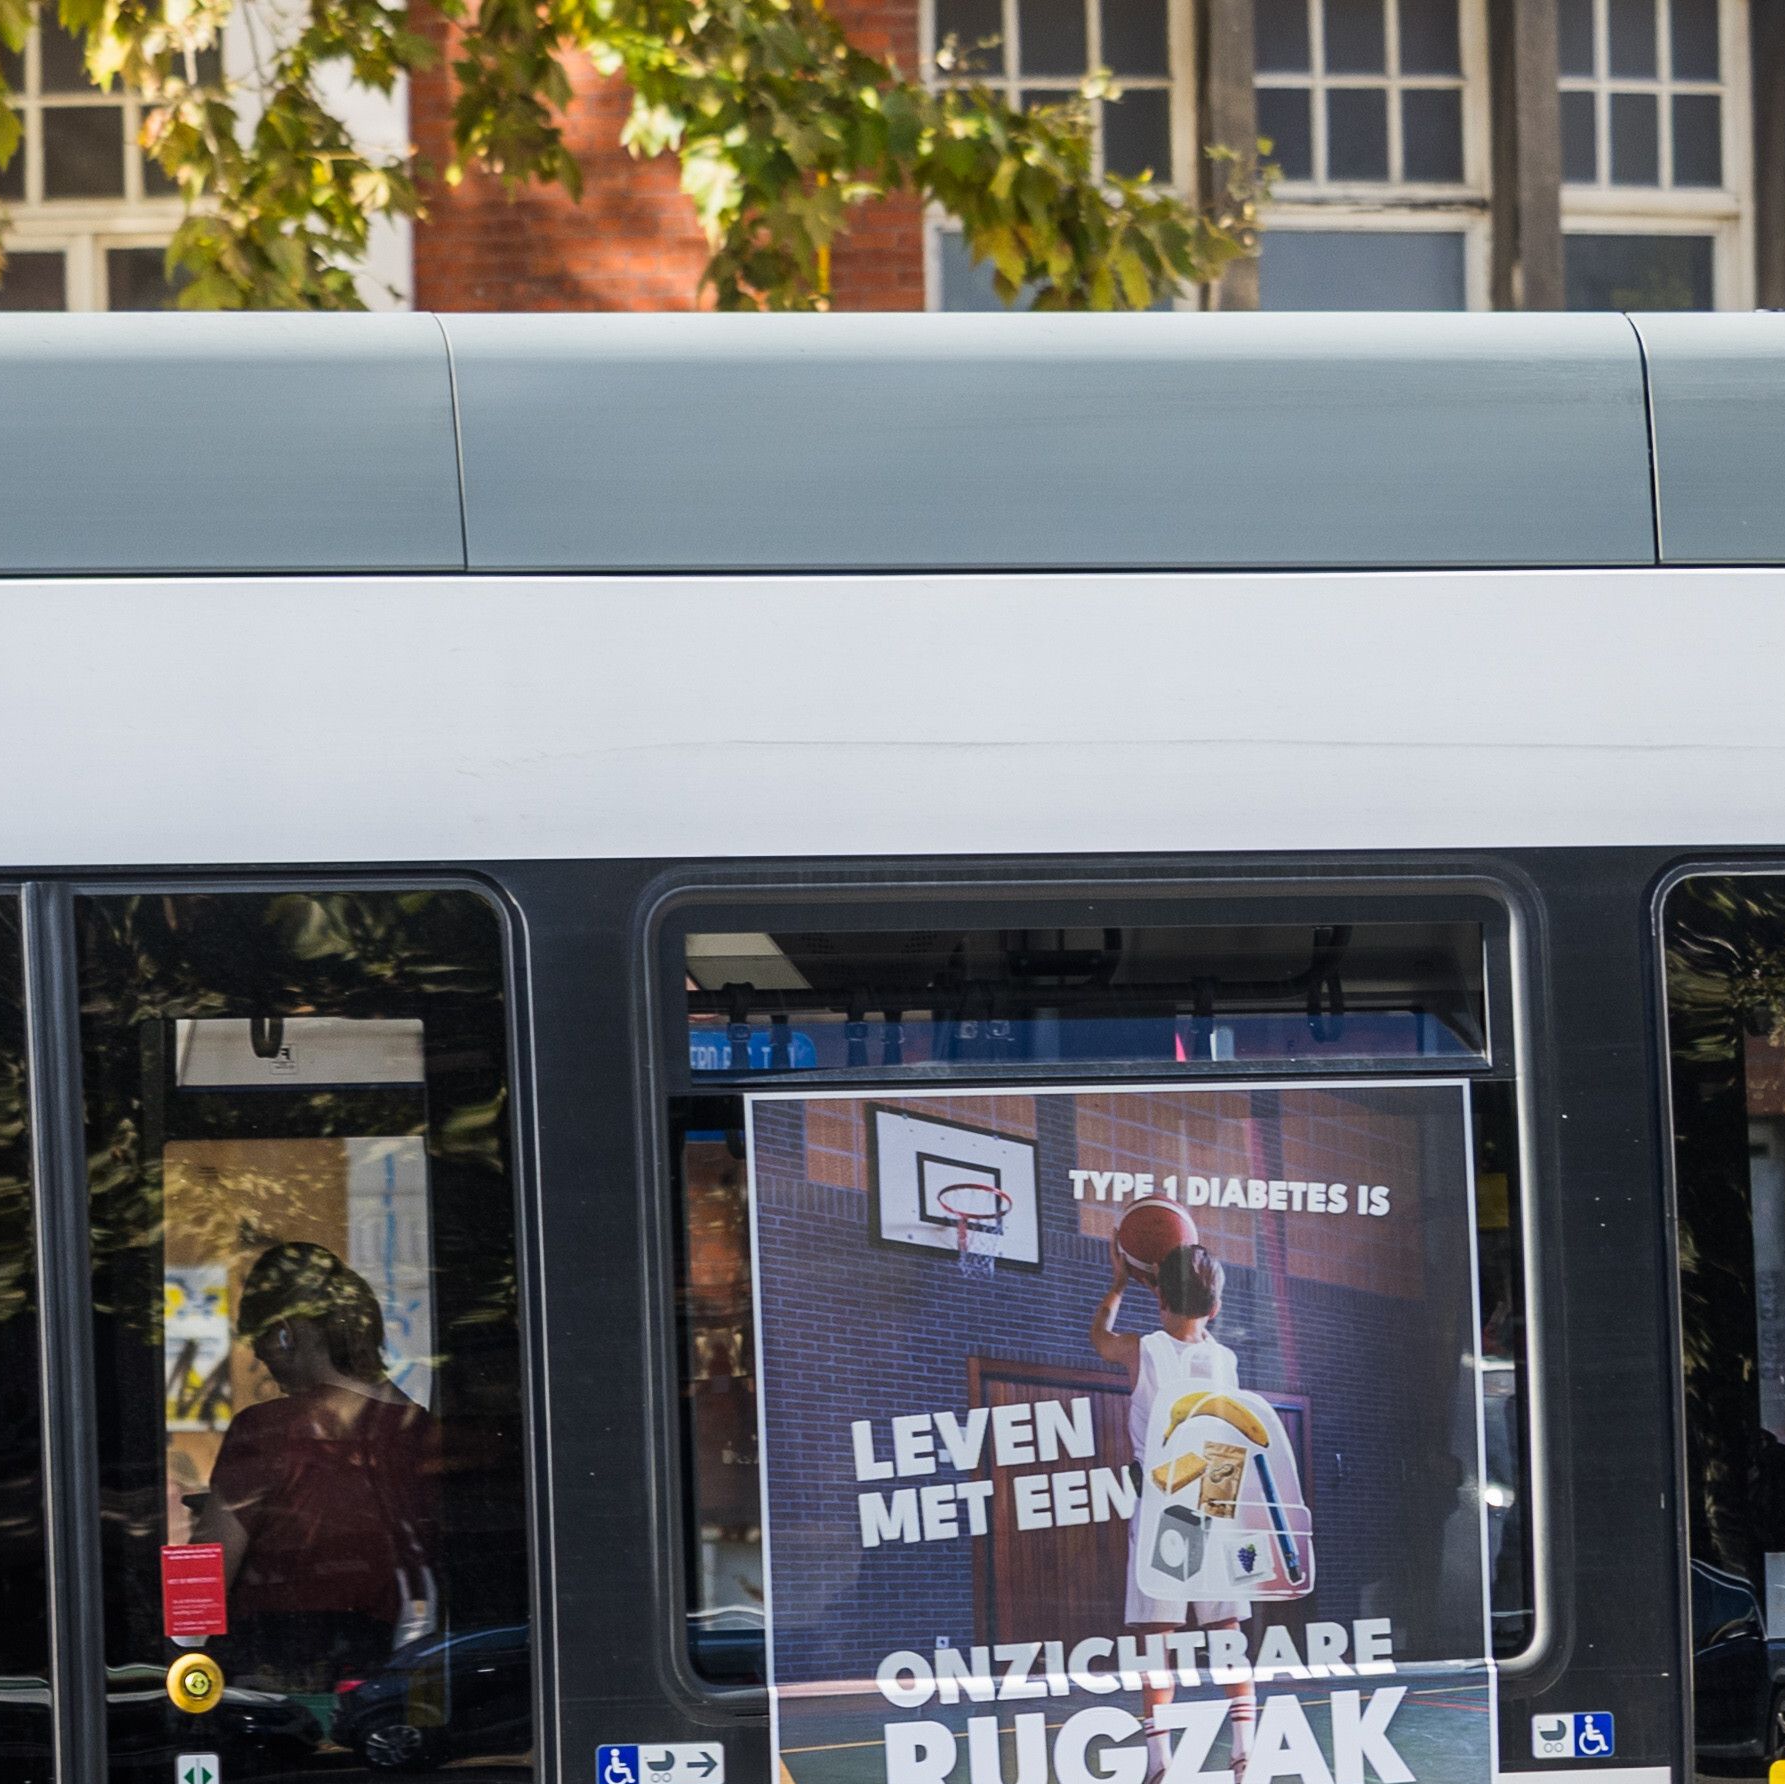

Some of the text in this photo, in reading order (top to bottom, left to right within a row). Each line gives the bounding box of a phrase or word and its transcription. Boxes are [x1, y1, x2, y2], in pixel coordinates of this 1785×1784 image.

[1069, 1170, 1391, 1216] TYPE 1 DIABETES IS
[851, 1397, 1095, 1482] LEVEN
[858, 1464, 1139, 1548] MET EEN
[875, 1617, 1398, 1708] ONZICHTBARE
